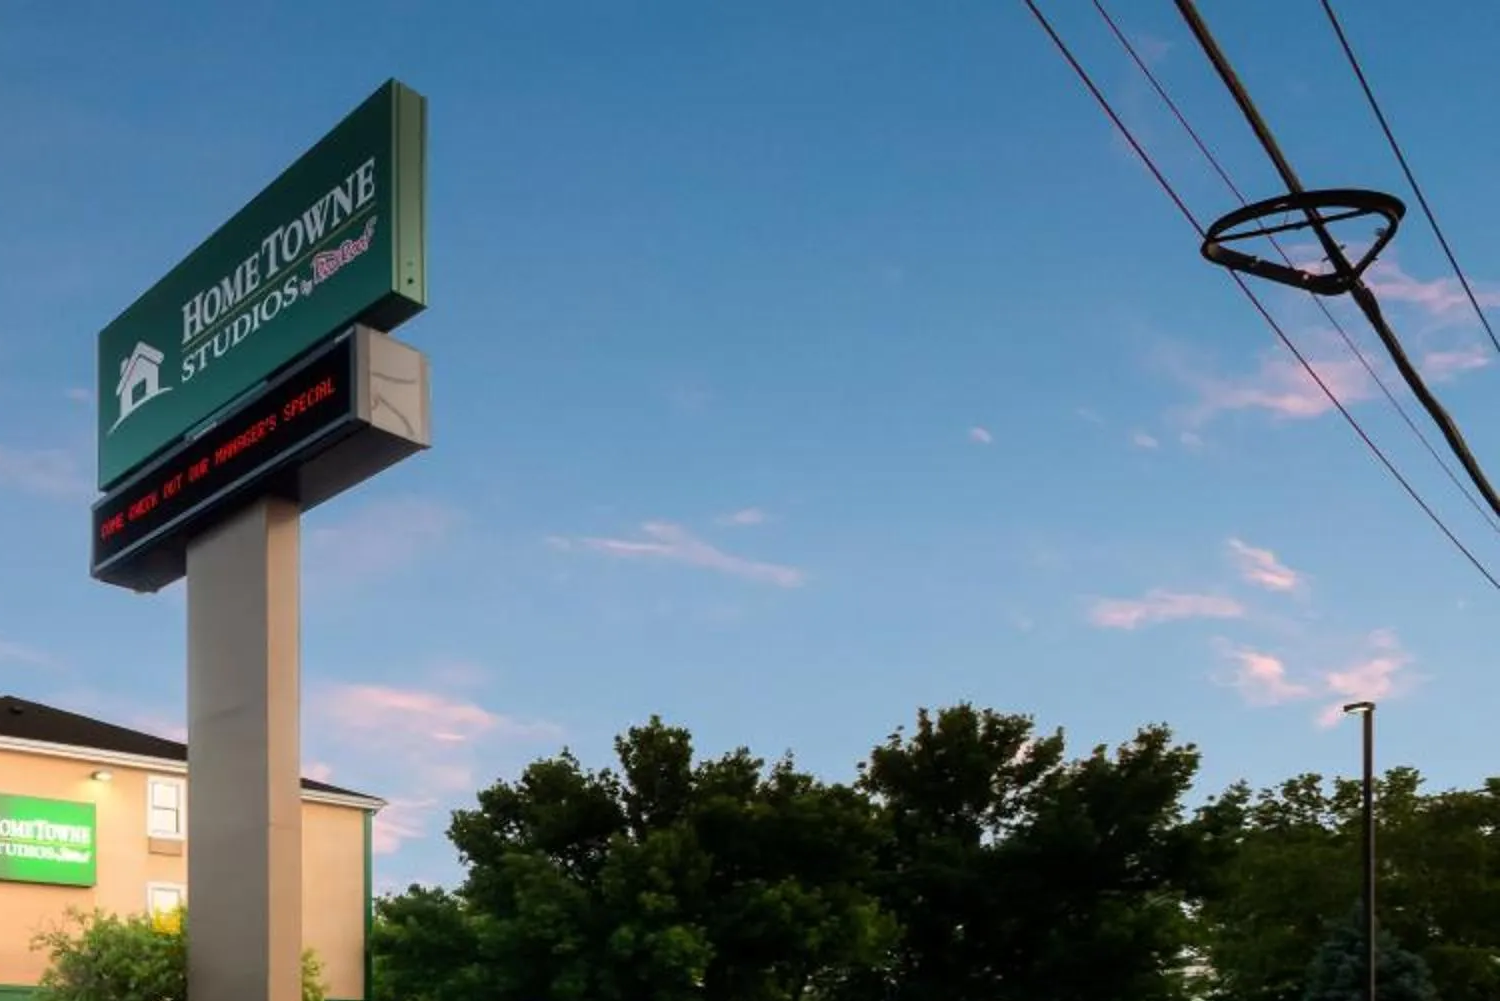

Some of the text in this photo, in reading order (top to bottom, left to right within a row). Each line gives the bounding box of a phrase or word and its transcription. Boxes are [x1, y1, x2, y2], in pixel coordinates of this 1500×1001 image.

[181, 276, 299, 382] STUDIOS
[163, 473, 182, 499] OUT
[283, 377, 337, 421] SPECIAL
